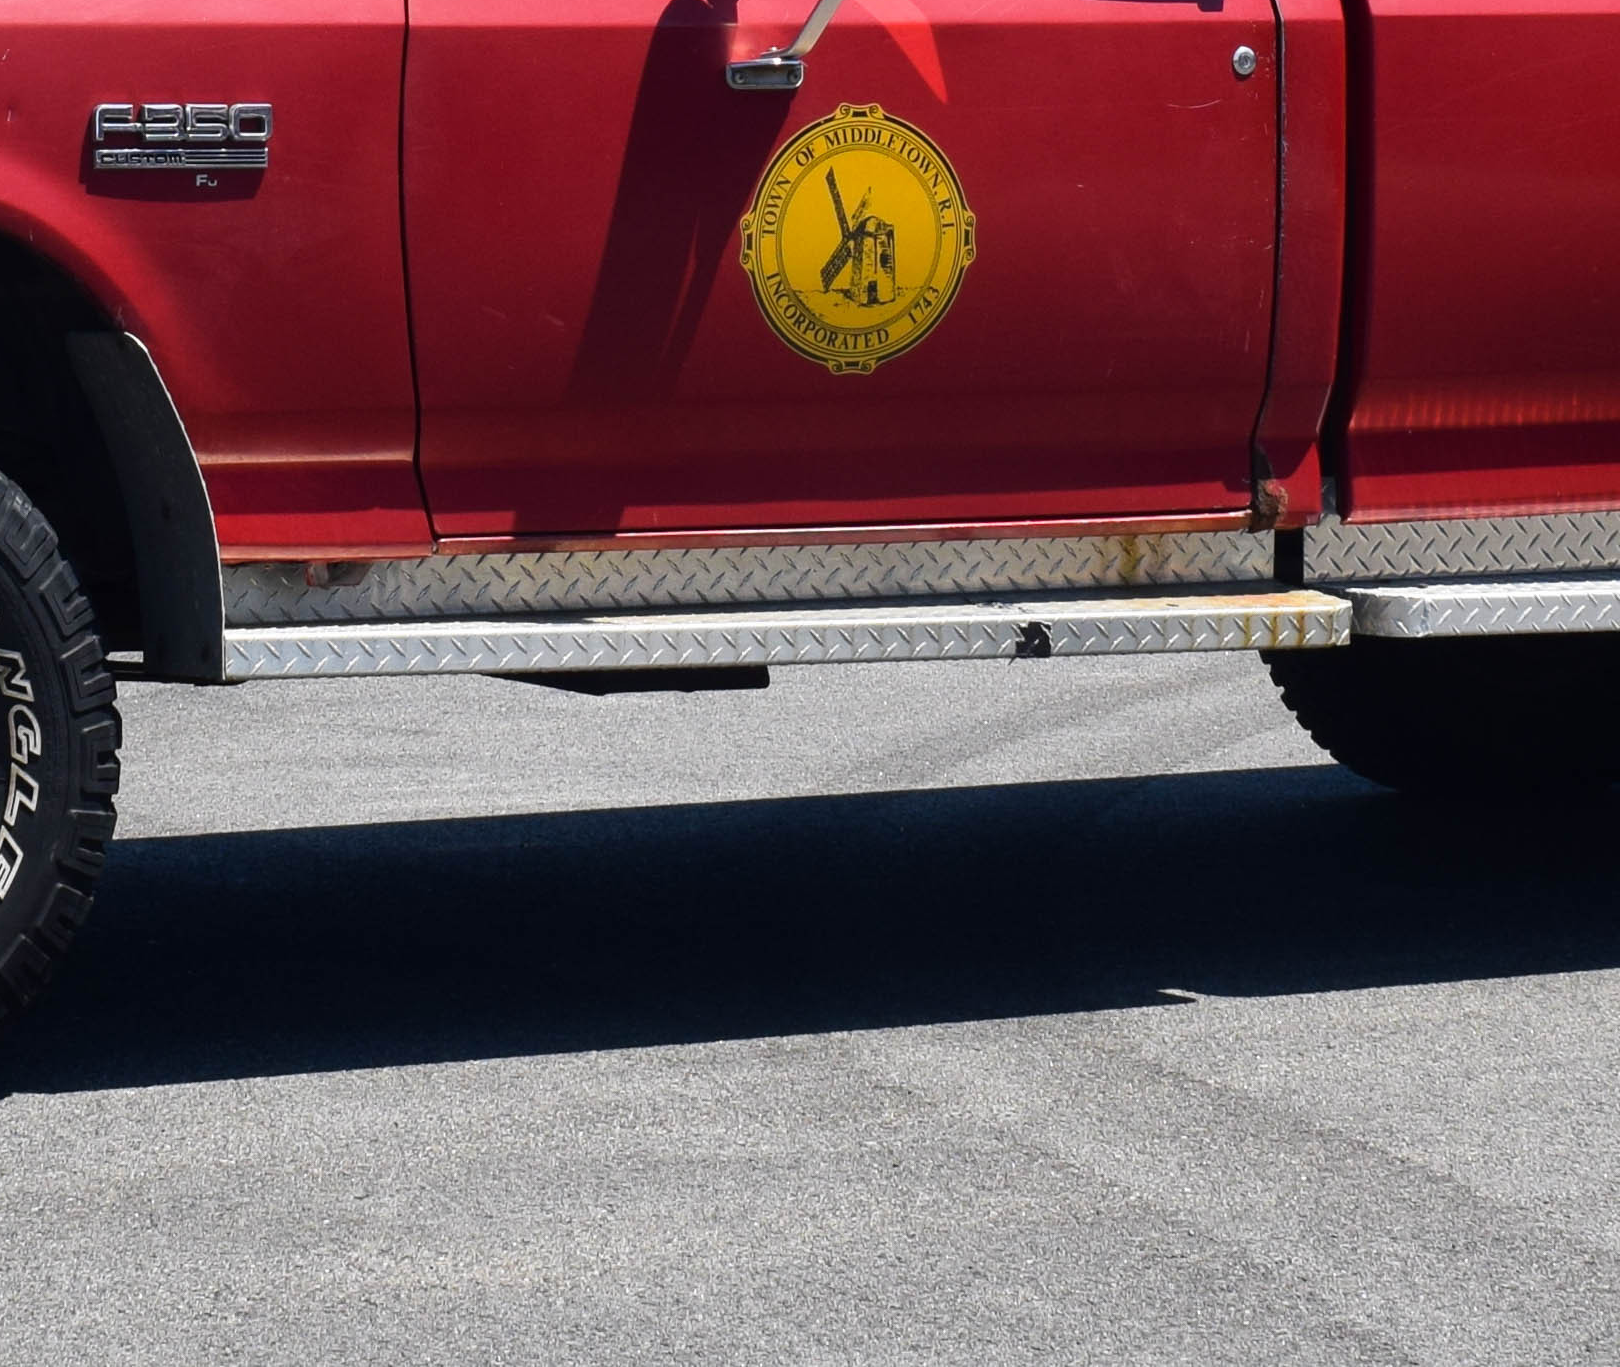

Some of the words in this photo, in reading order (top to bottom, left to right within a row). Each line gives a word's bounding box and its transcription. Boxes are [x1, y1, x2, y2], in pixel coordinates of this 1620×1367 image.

[94, 103, 273, 141] F-350
[761, 174, 792, 239] TOWN
[795, 143, 817, 168] OF
[766, 271, 890, 351] INCORPORATED
[907, 288, 940, 326] 1743
